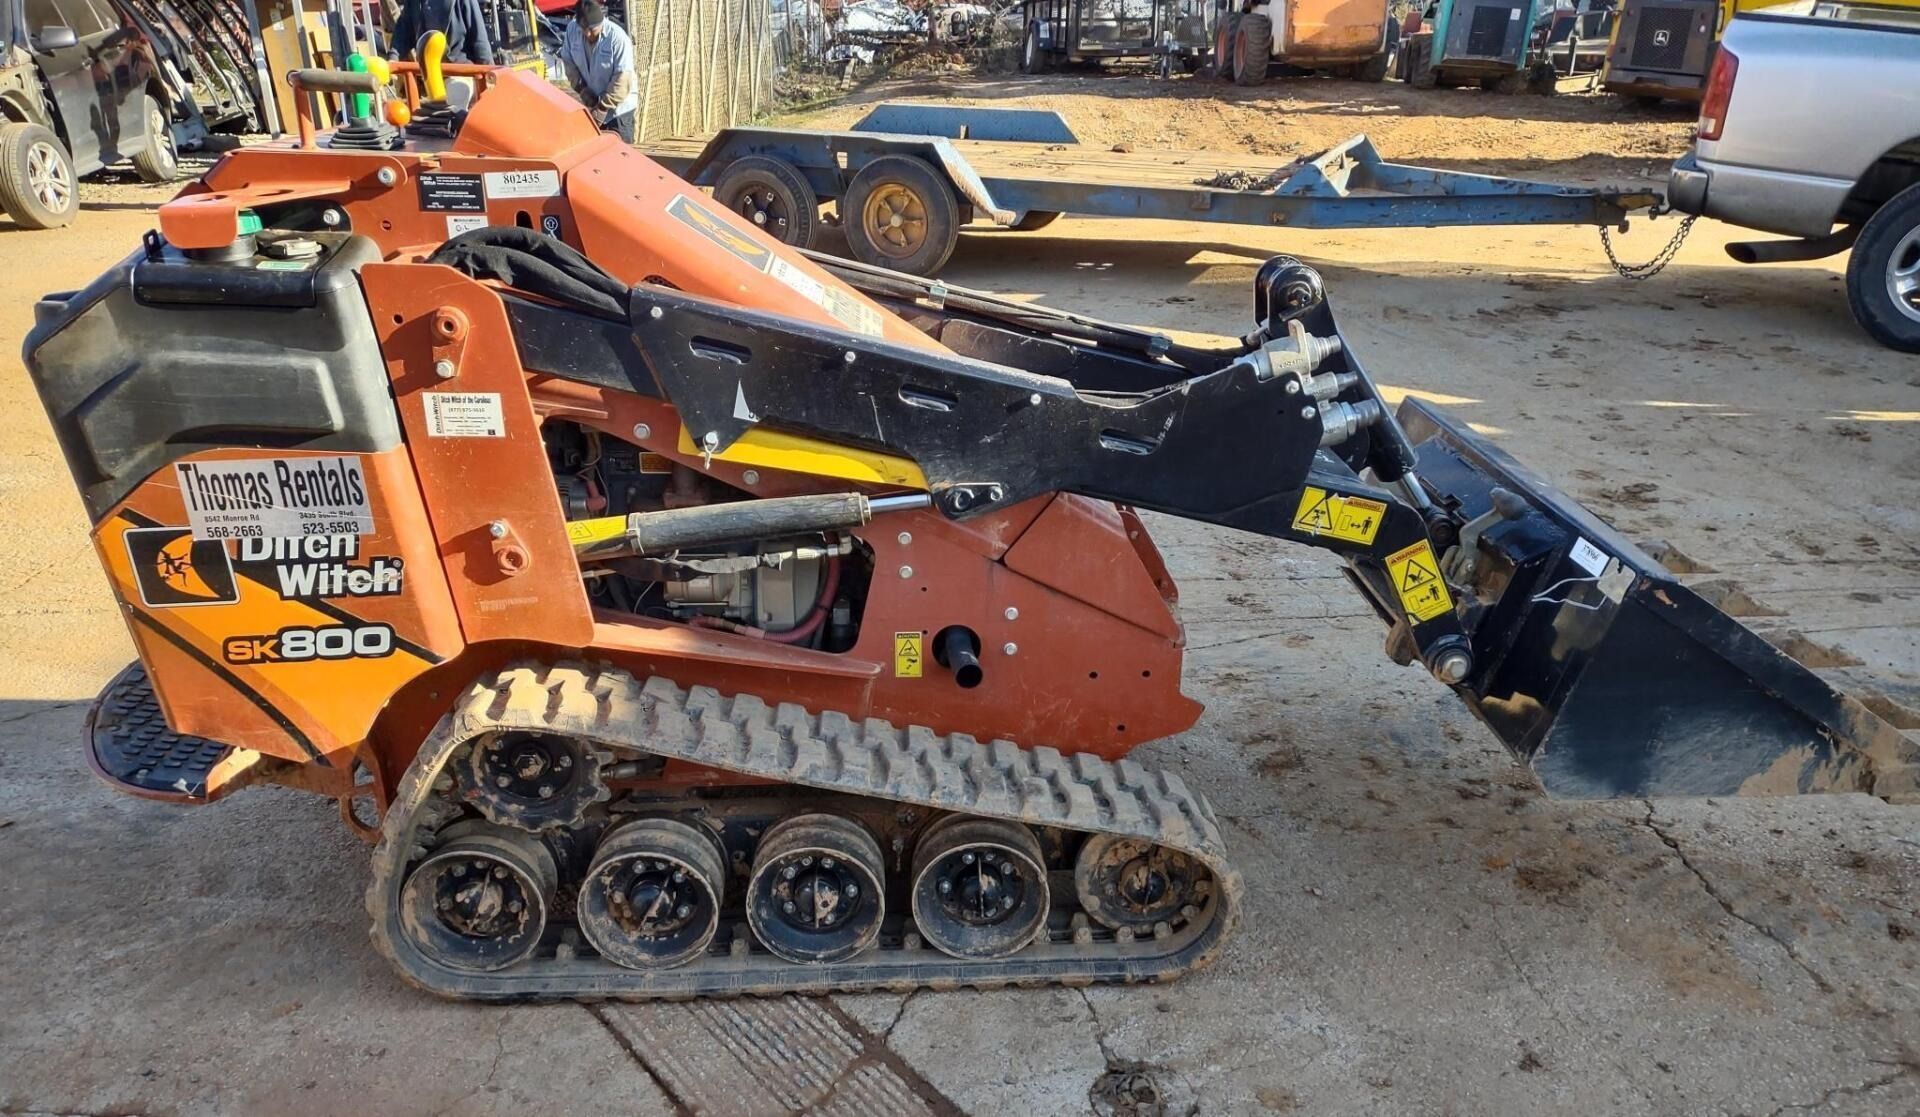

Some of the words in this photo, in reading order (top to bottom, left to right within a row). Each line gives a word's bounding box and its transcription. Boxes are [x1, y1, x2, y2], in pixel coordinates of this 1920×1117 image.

[503, 174, 540, 185] 802435
[178, 463, 274, 511] Thomas
[273, 458, 364, 508] Rentals
[206, 525, 264, 538] 568-2663
[302, 521, 360, 534] 523-5503
[1396, 545, 1426, 561] WARNING
[227, 626, 391, 661] SK800
